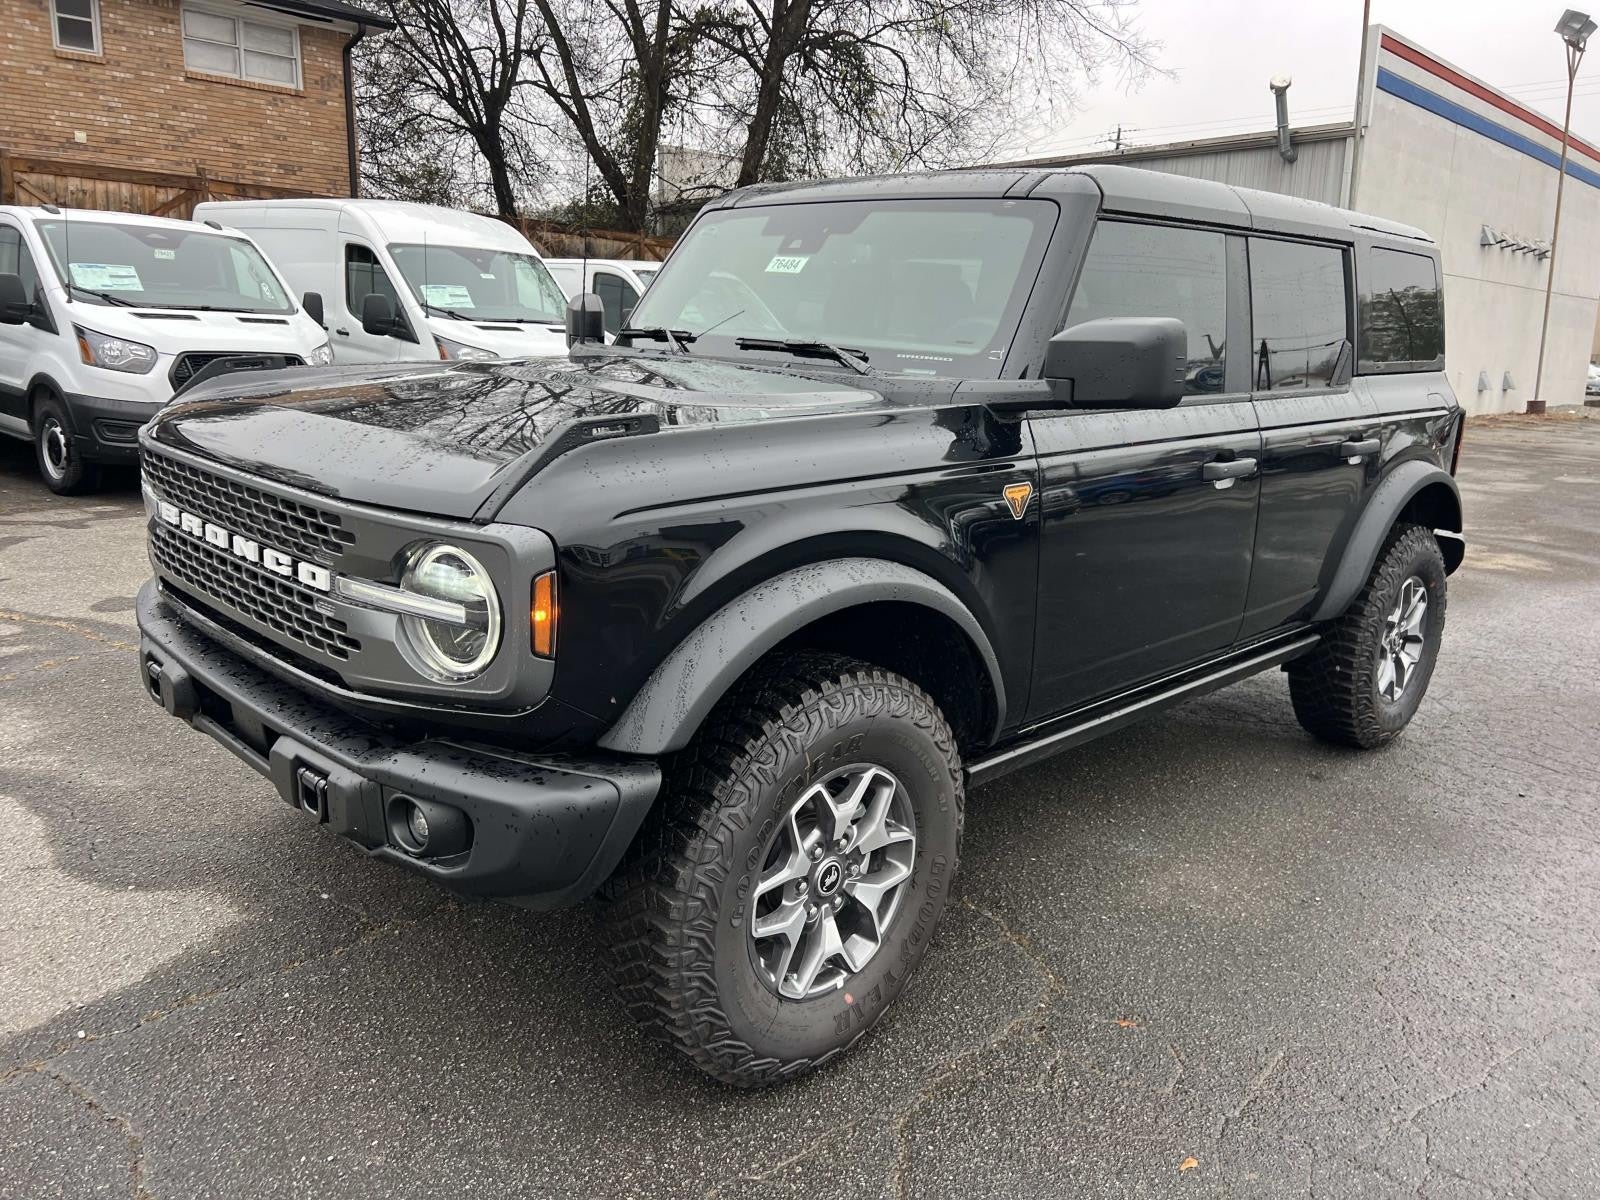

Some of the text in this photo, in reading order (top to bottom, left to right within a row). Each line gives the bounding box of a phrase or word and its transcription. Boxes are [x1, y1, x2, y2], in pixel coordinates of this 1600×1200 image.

[771, 258, 801, 270] 76484
[160, 501, 331, 592] BRONCO
[833, 854, 948, 1036] GOODYEAR
